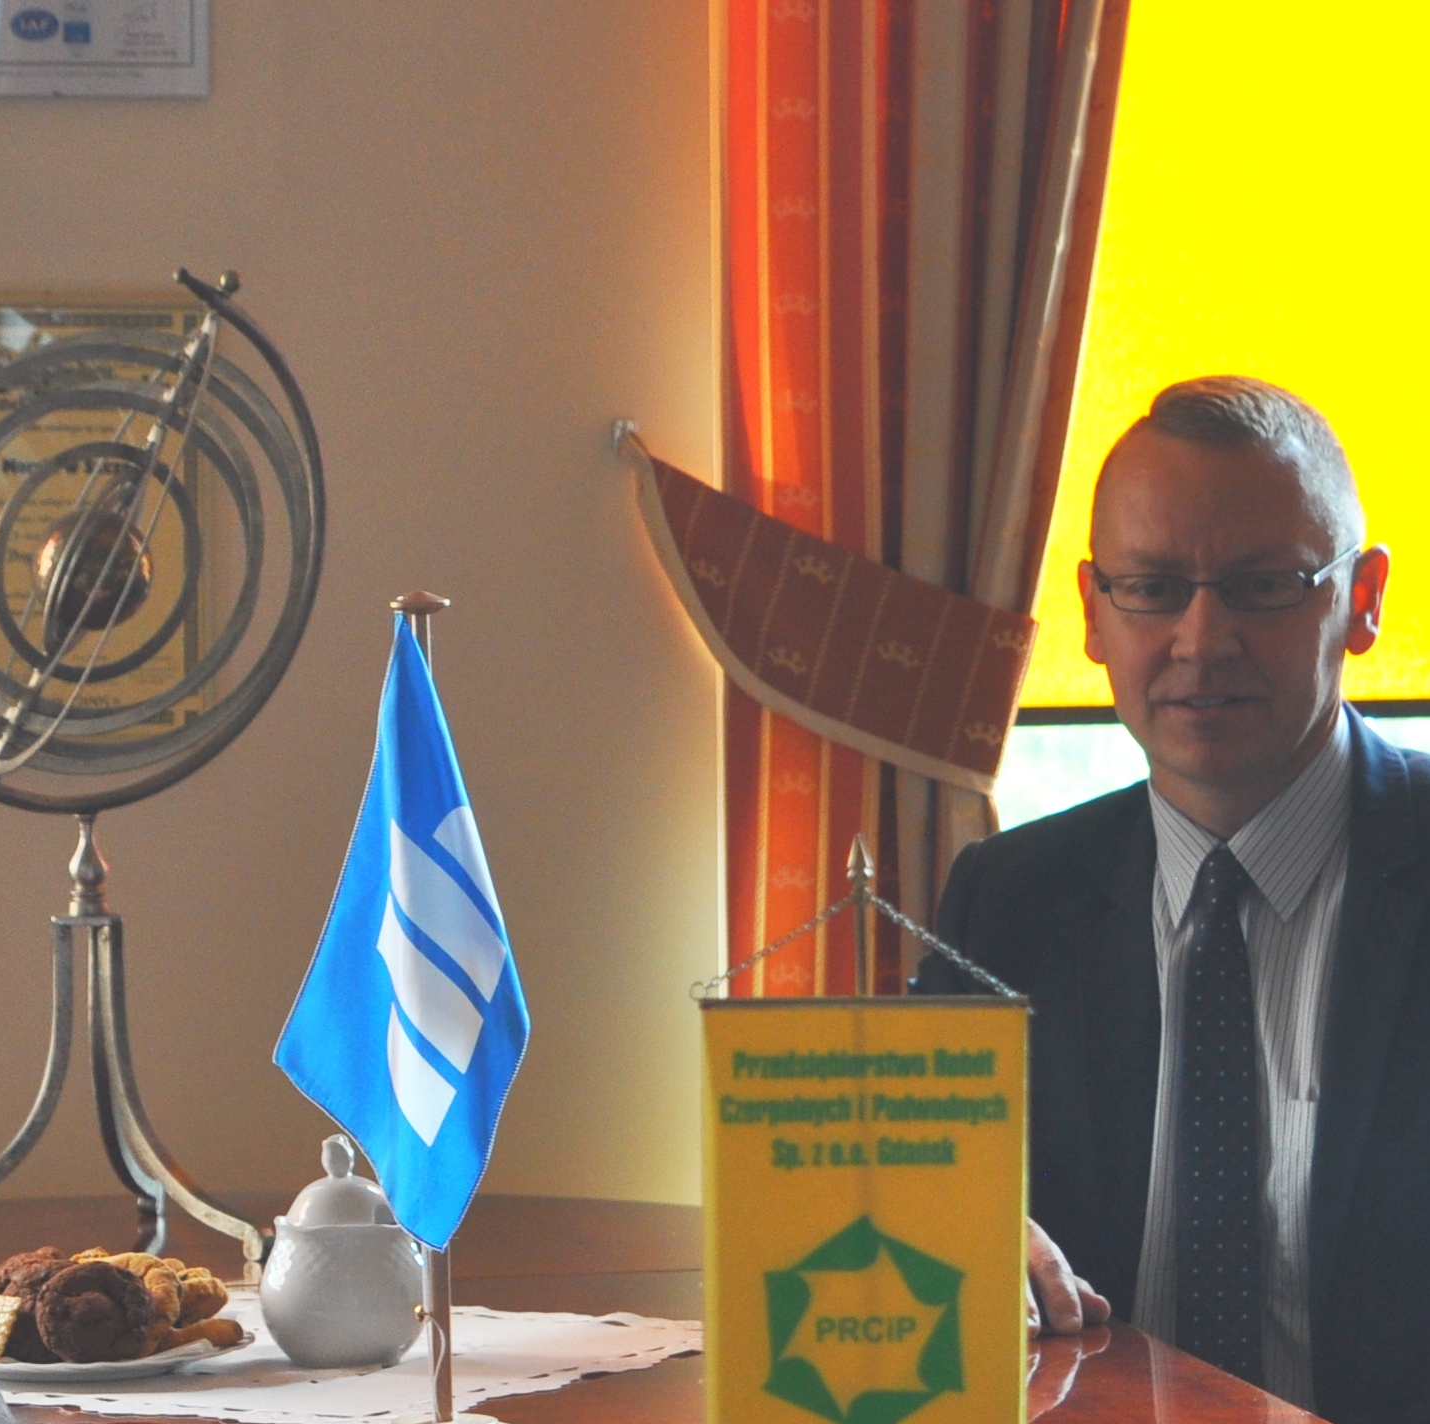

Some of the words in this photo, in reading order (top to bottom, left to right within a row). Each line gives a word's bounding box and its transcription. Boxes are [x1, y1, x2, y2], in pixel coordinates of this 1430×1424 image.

[720, 1095, 851, 1126] Czerpalnych
[858, 1095, 867, 1121] i
[872, 1094, 1007, 1125] Podwodnych
[772, 1138, 804, 1170] Sp.
[812, 1143, 823, 1167] z
[877, 1136, 955, 1166] Gdańsk
[815, 1316, 917, 1343] PRCiP
